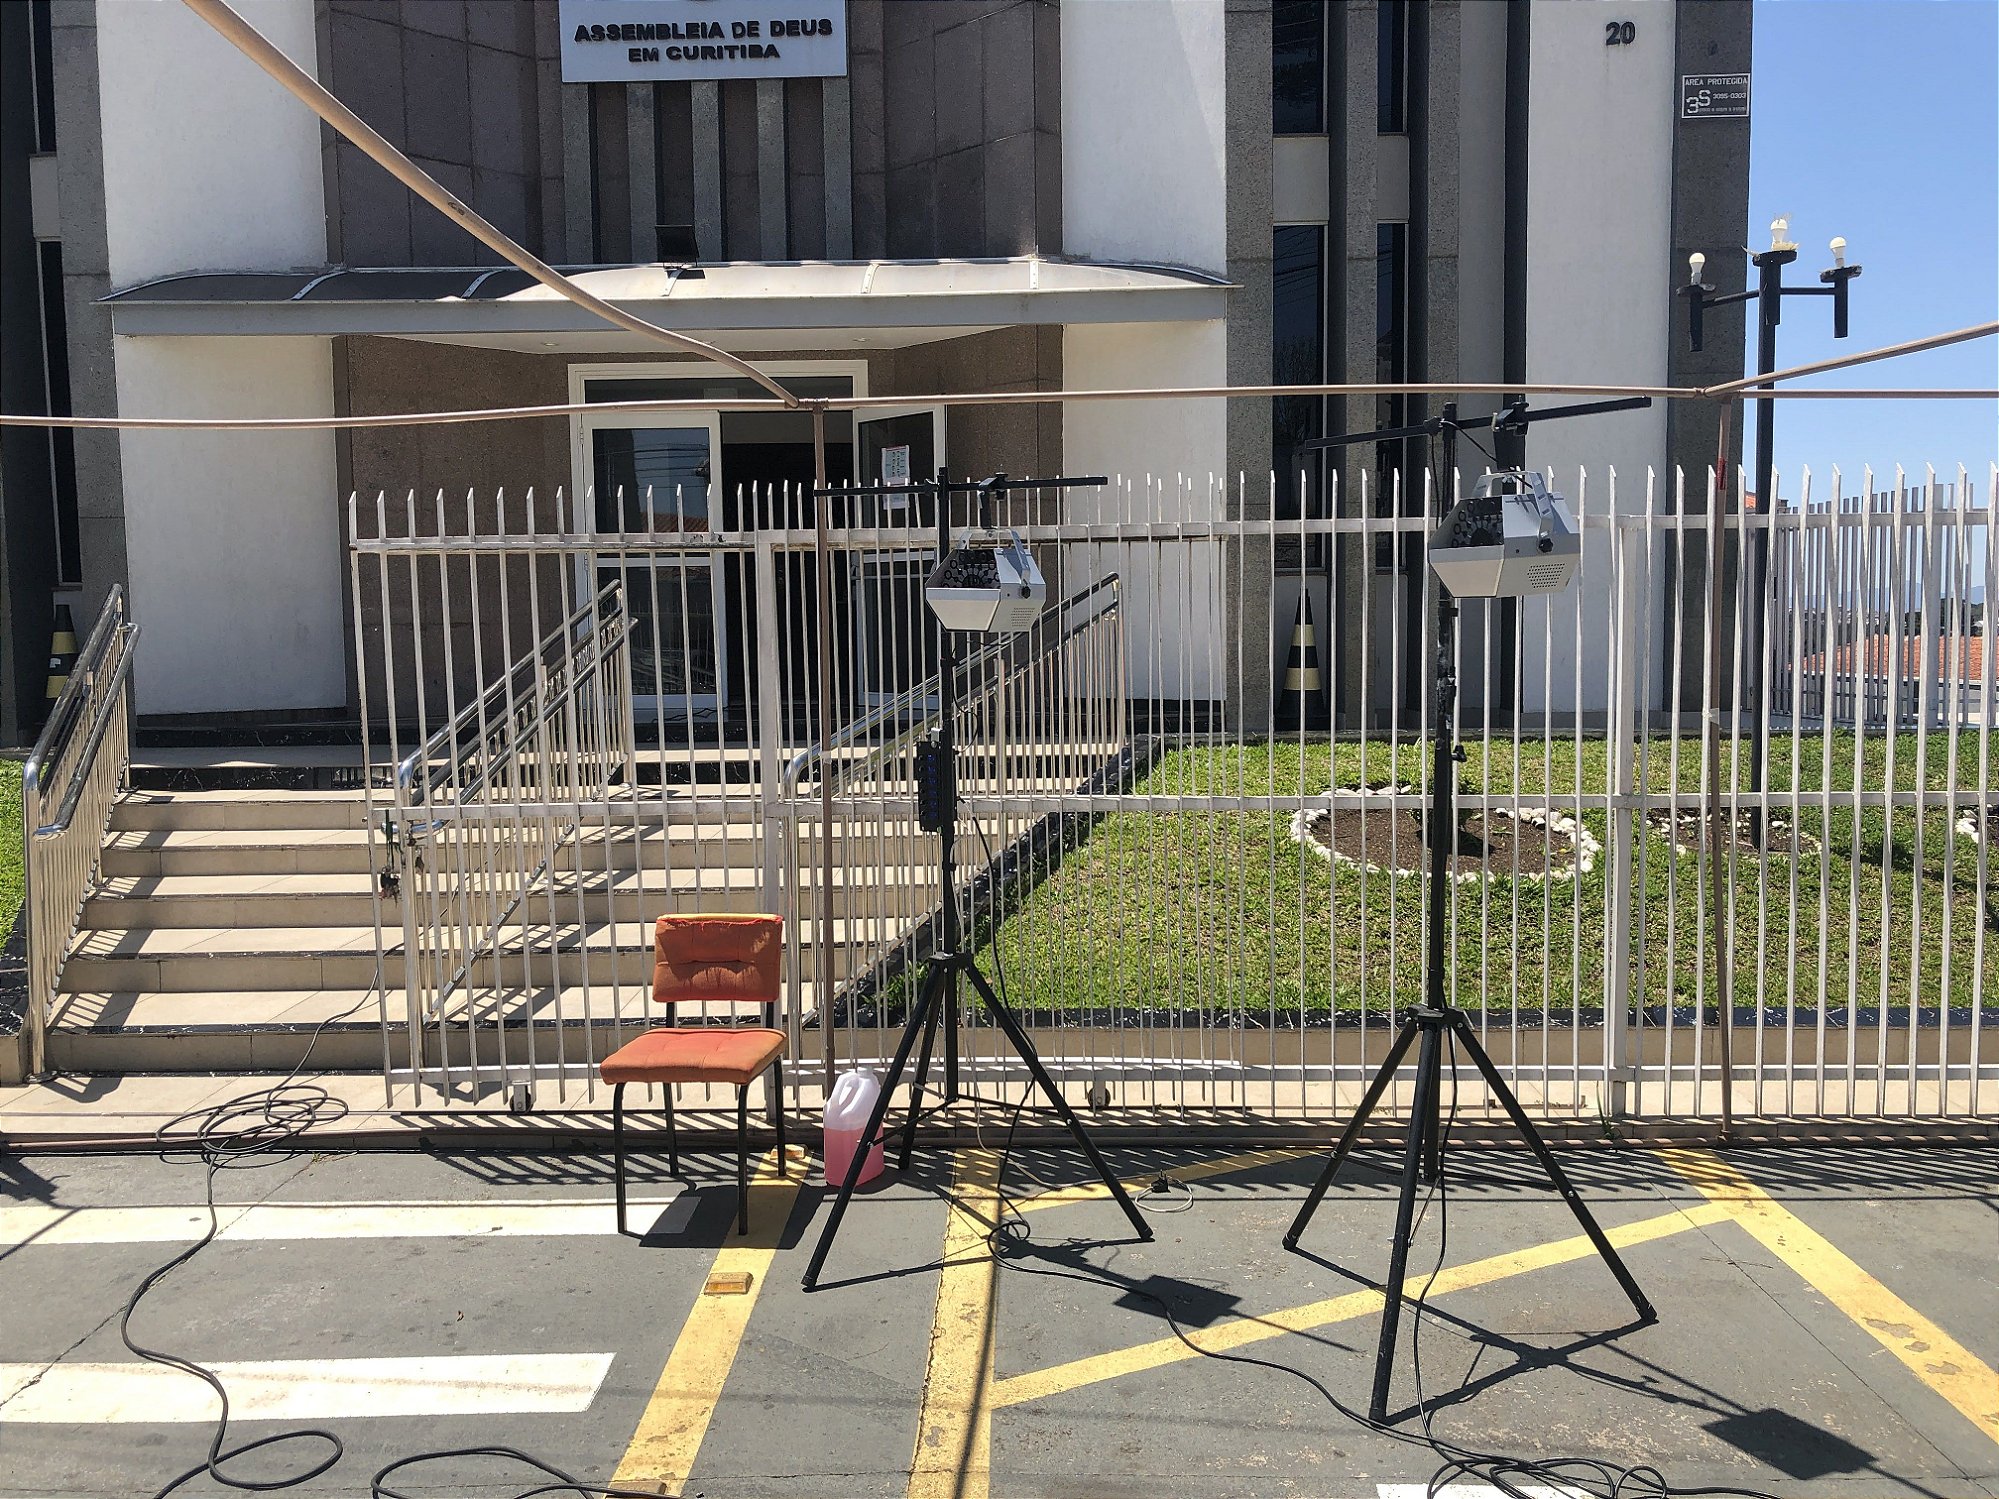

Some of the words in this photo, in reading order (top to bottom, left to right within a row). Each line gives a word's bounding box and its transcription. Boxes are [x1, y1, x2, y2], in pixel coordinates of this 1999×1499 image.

[574, 22, 725, 42] ASSEMBLEIA
[731, 21, 760, 39] DE
[770, 19, 833, 37] DEUS
[1605, 21, 1636, 46] 20
[628, 47, 659, 62] EM
[666, 44, 780, 60] CURITIBA
[1707, 77, 1748, 85] PROTEGIDA
